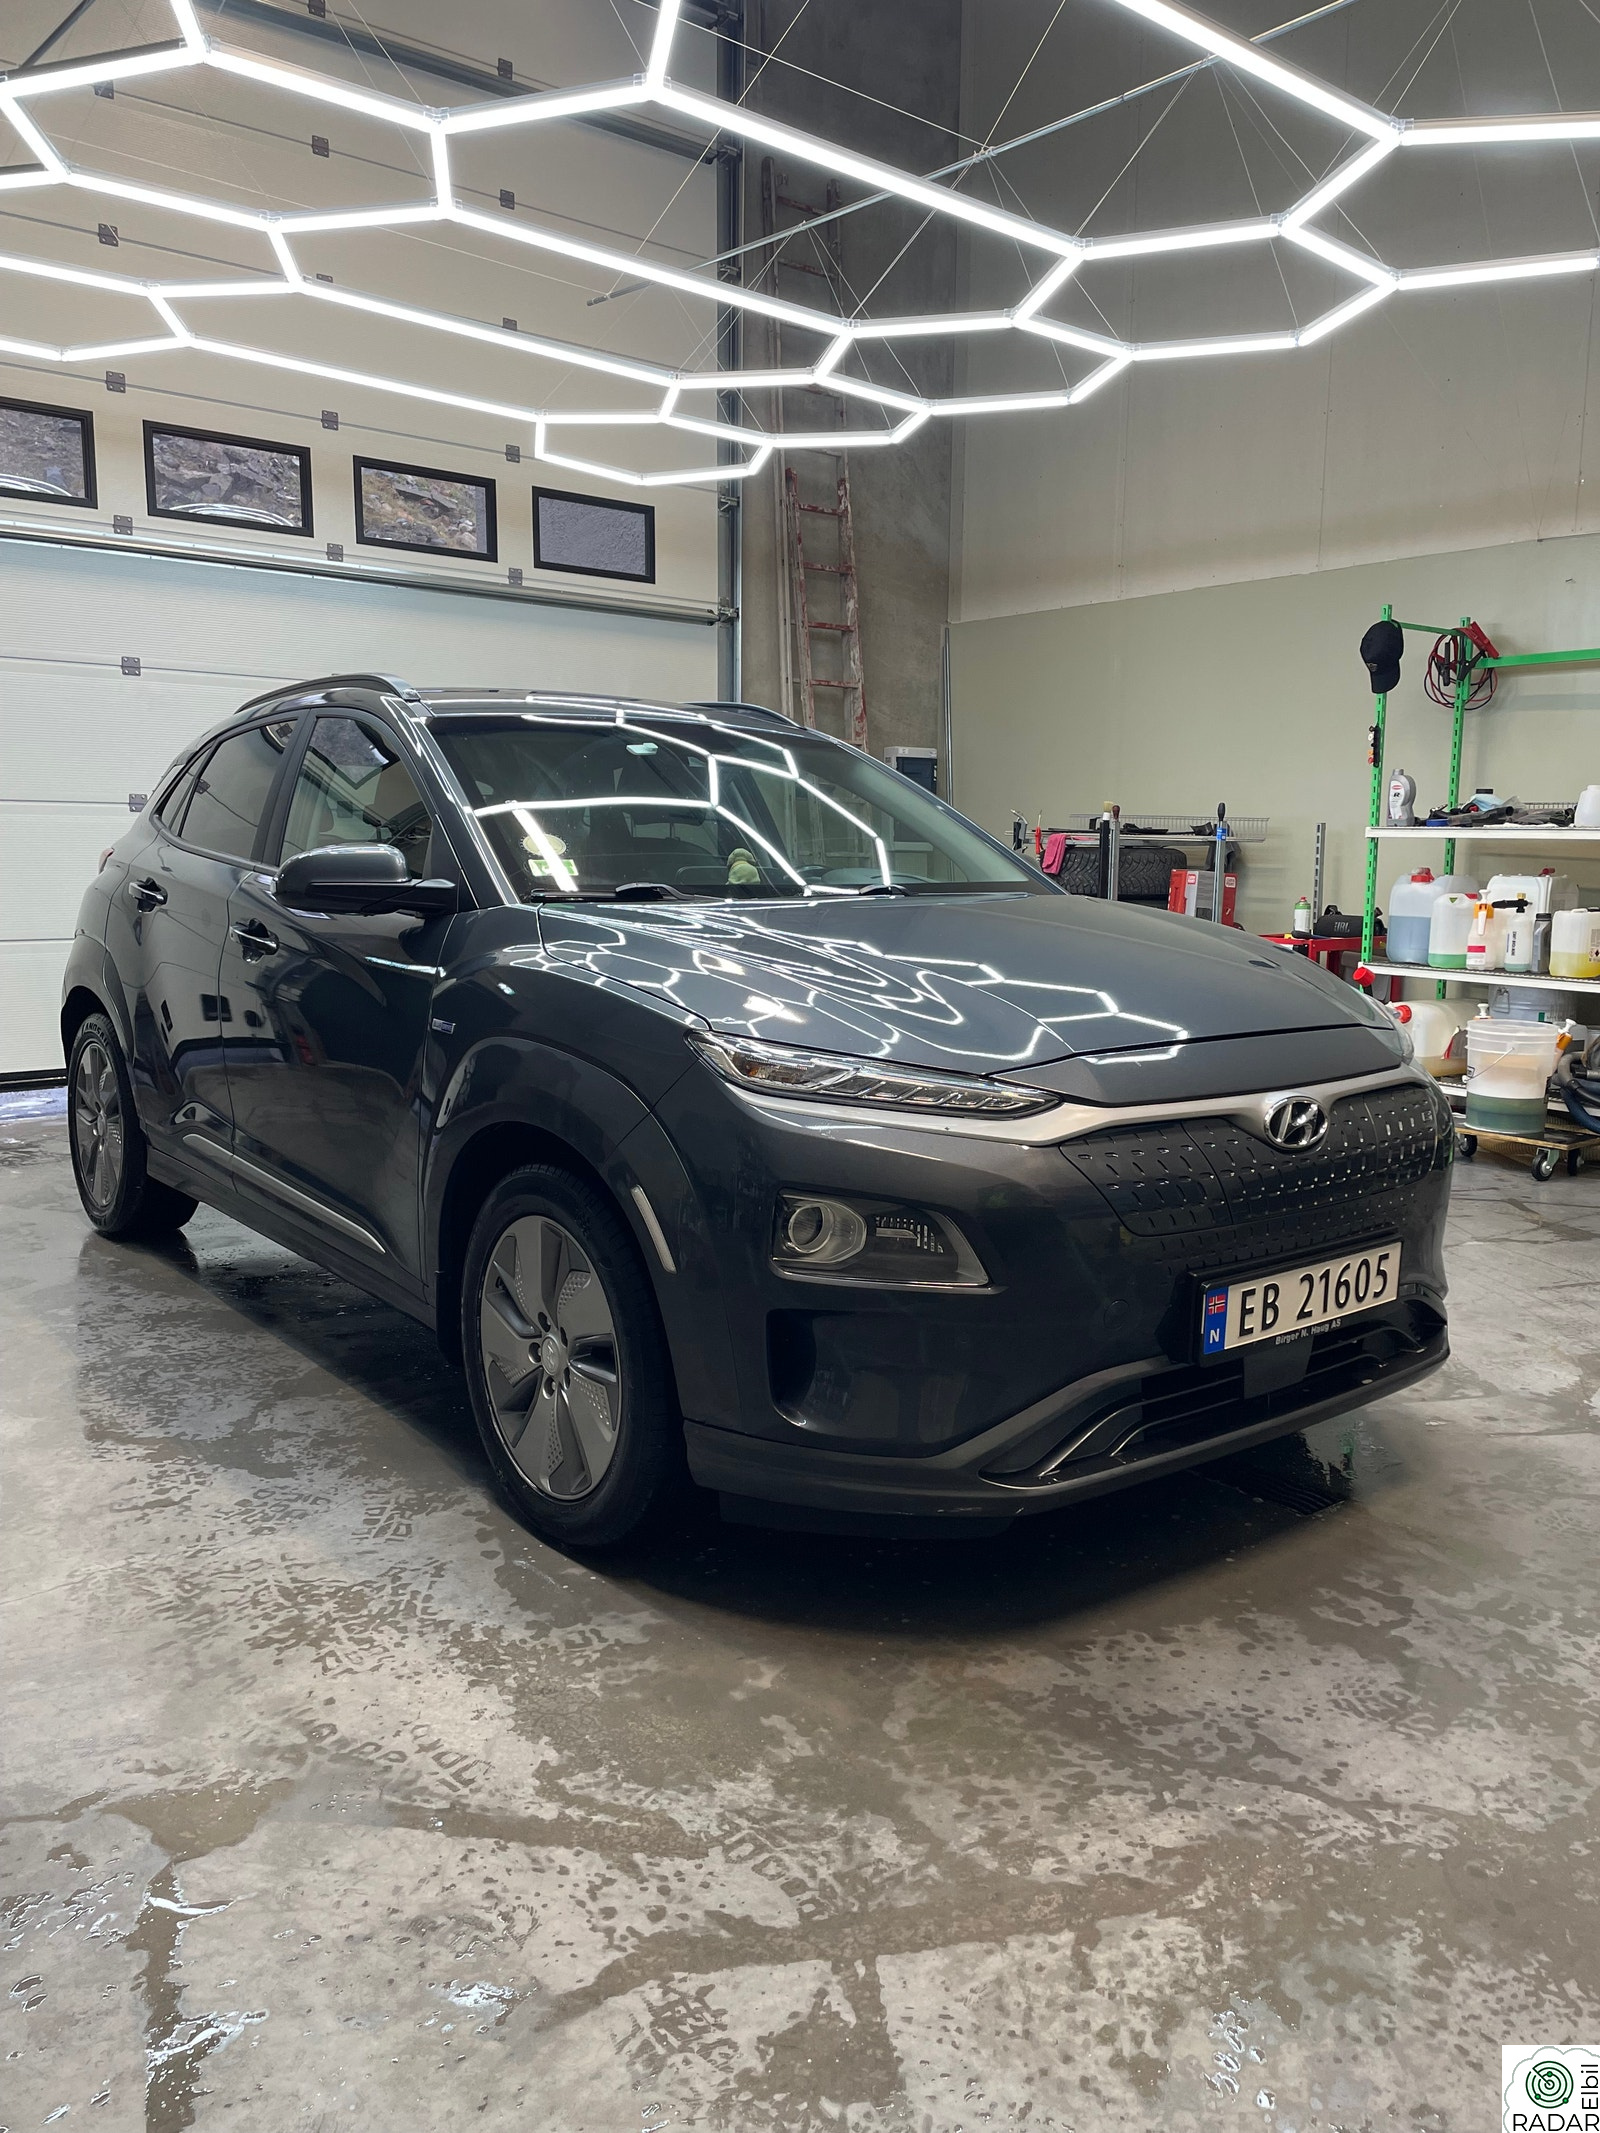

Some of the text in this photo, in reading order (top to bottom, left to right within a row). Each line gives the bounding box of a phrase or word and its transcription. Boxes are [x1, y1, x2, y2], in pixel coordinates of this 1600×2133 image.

[1239, 1252, 1390, 1337] EB 21605
[1209, 1328, 1220, 1344] N
[1275, 1332, 1300, 1345] Birger
[1331, 1318, 1342, 1329] AS
